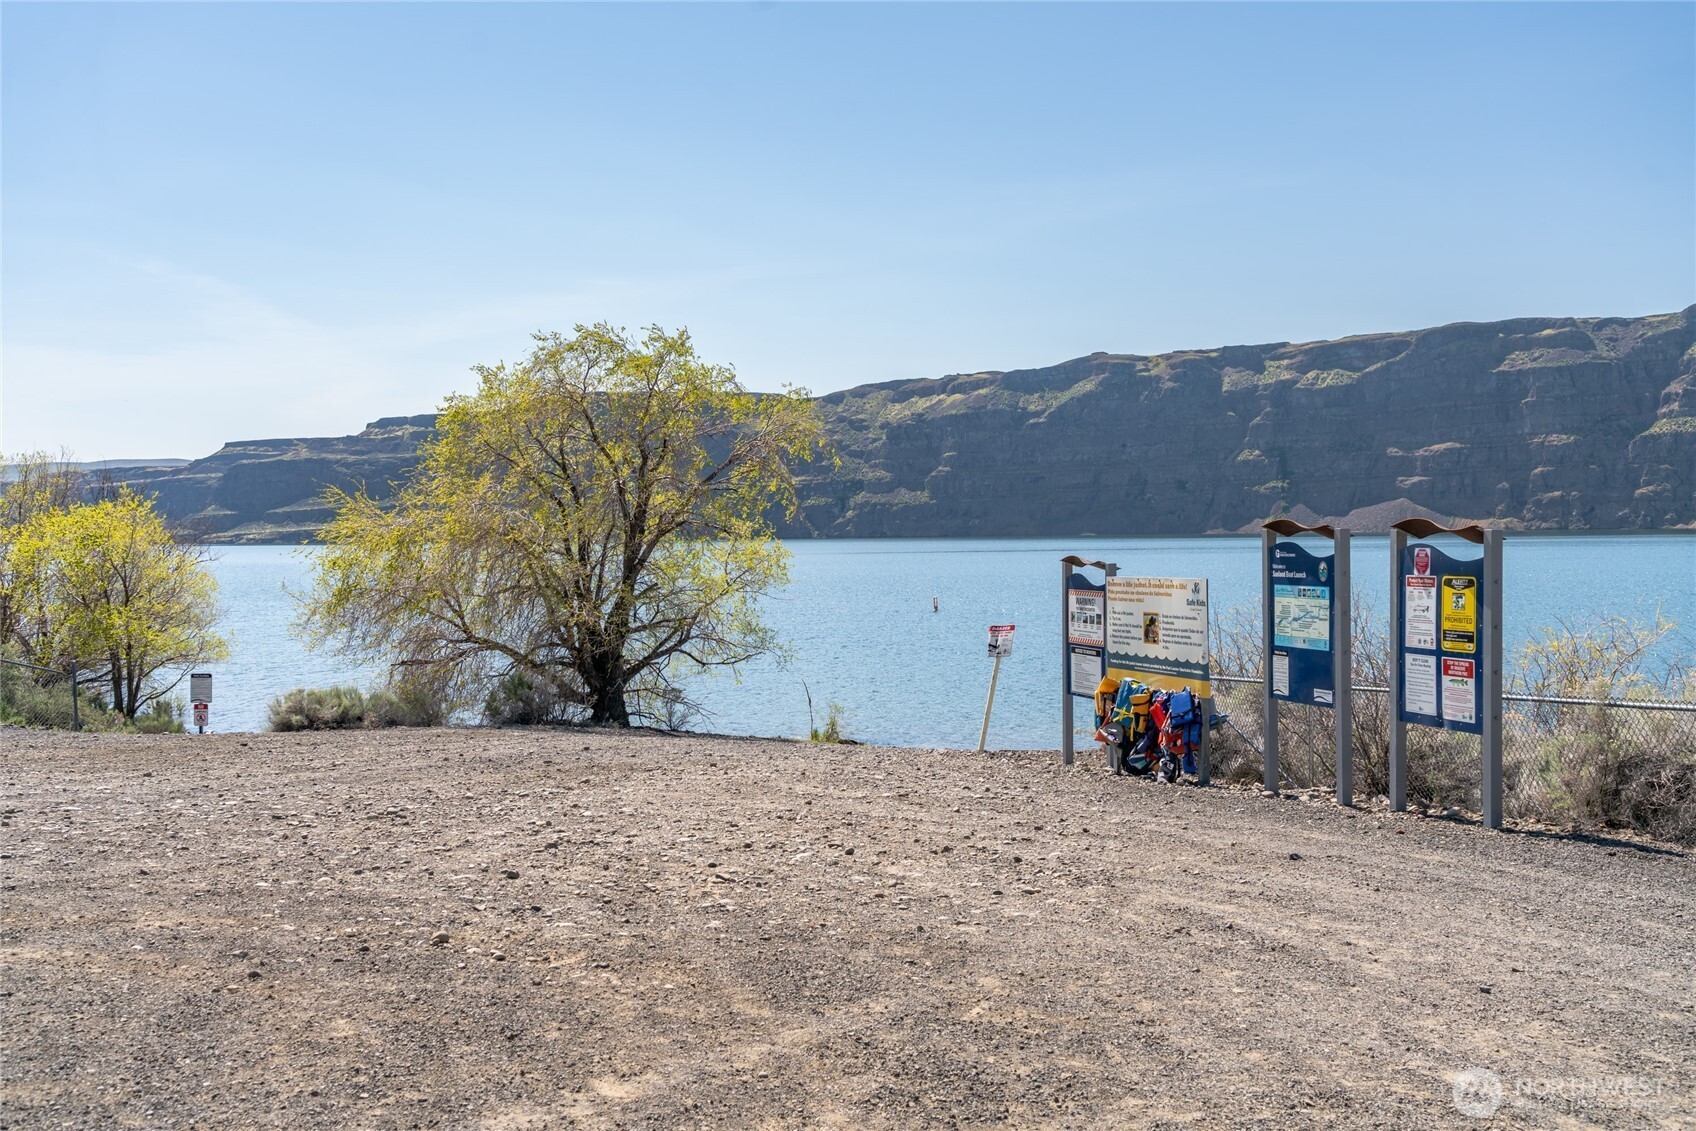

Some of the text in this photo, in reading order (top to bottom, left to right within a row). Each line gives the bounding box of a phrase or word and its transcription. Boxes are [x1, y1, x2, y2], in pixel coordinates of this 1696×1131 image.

[1186, 598, 1206, 607] Safe Kids
[1445, 616, 1472, 624] PROHIBITED
